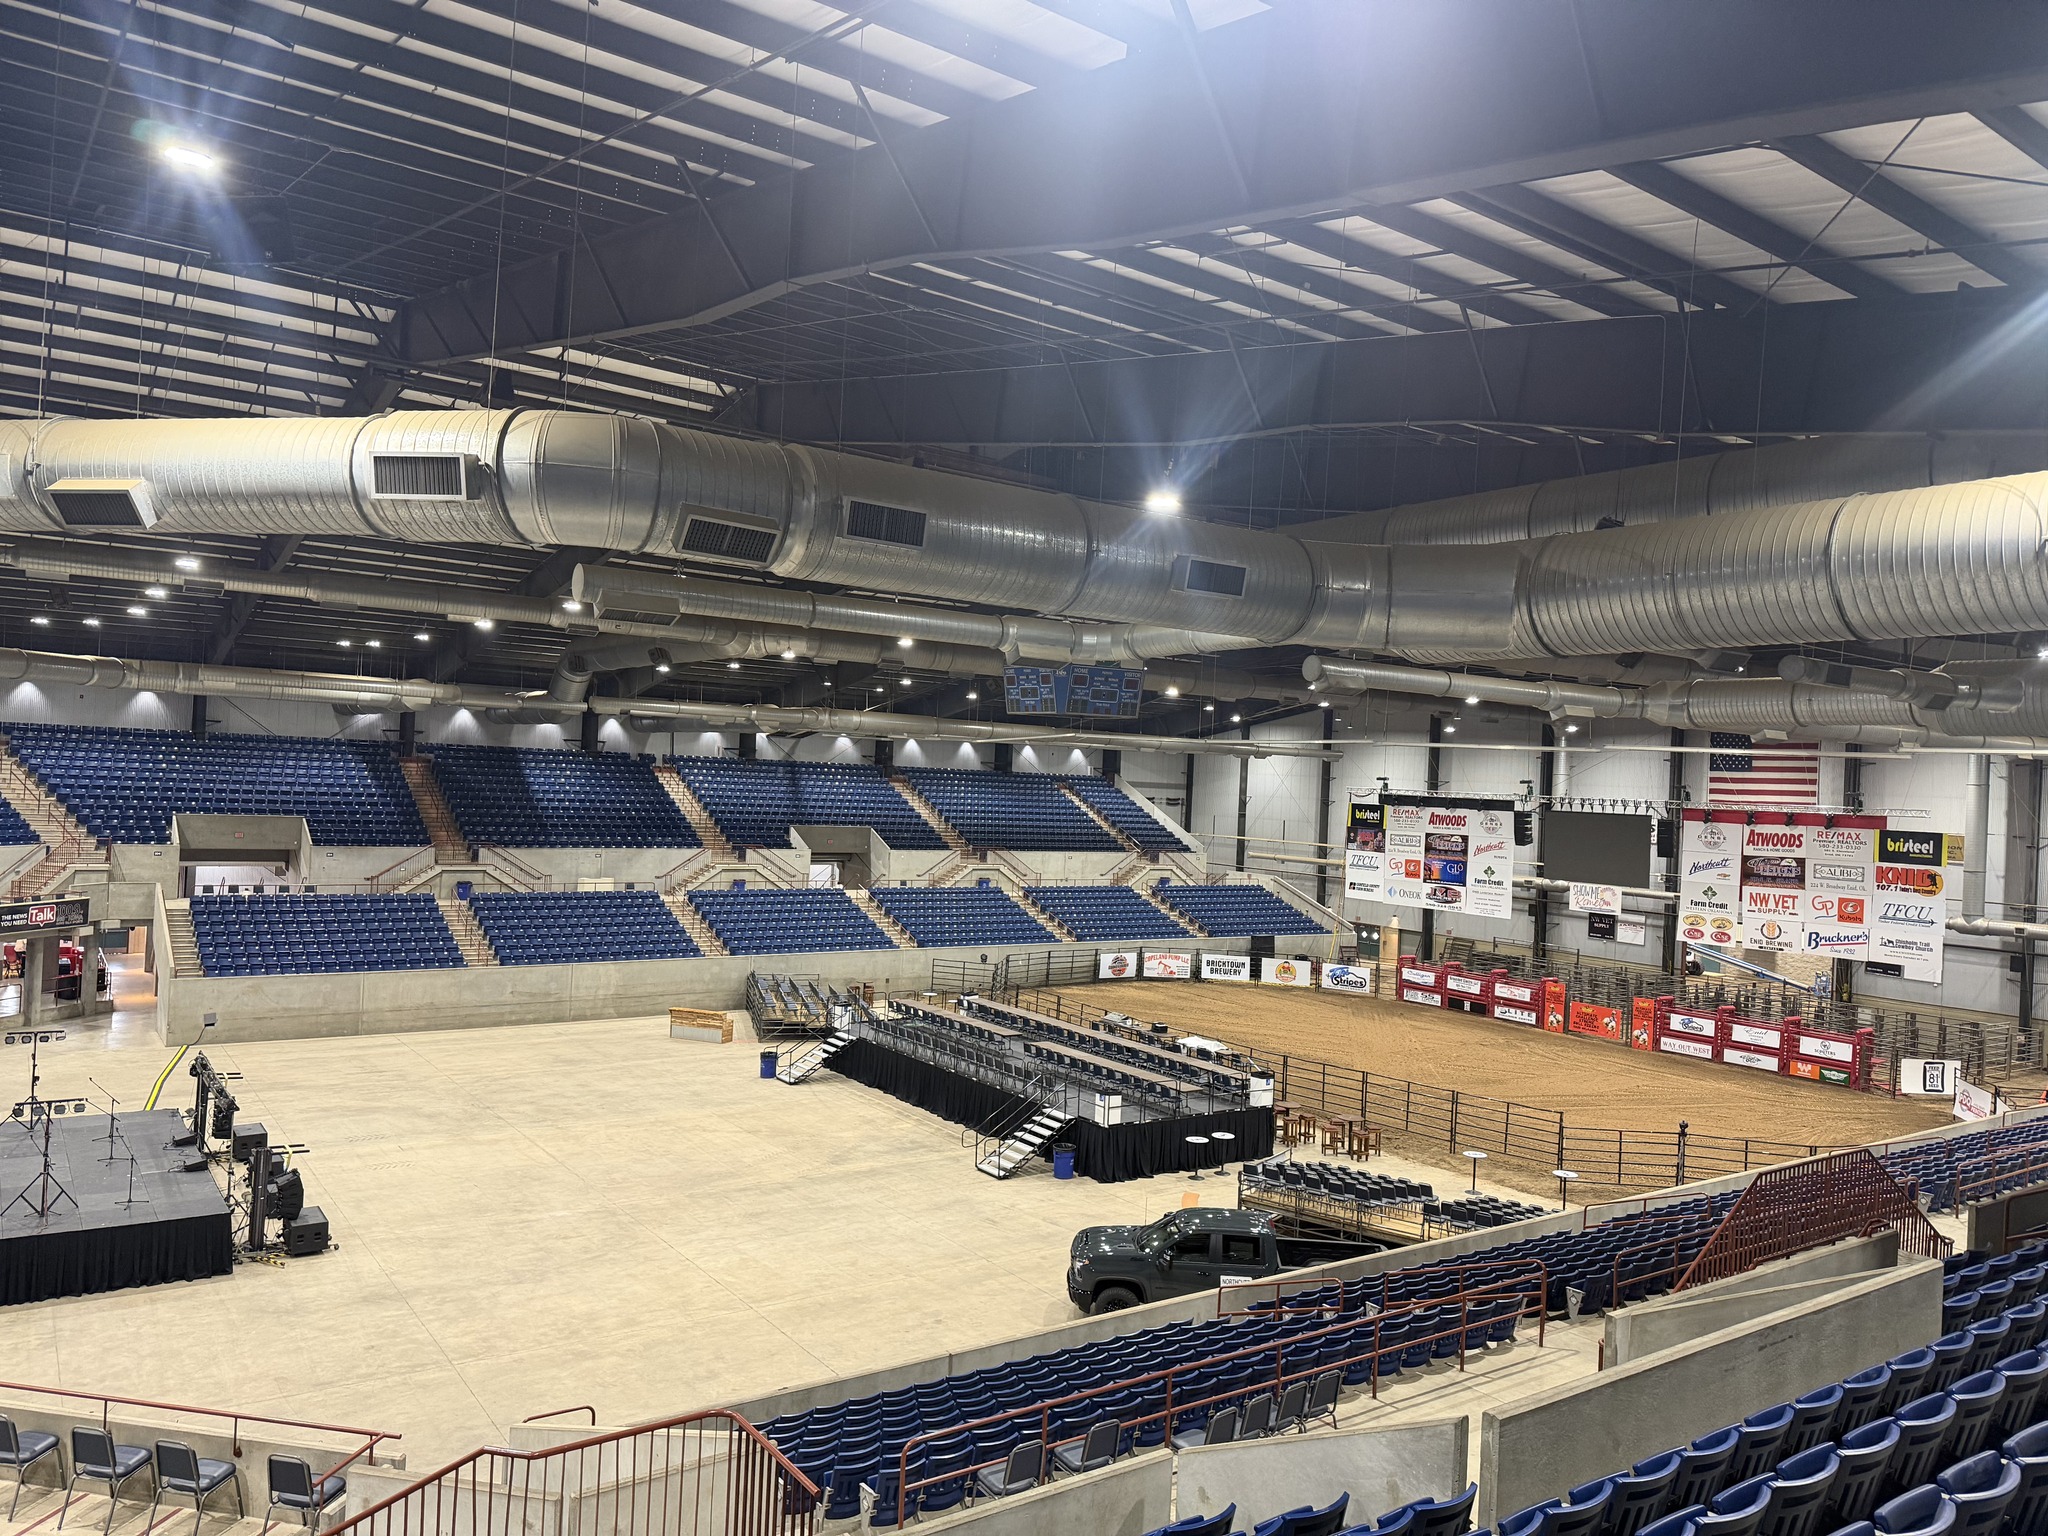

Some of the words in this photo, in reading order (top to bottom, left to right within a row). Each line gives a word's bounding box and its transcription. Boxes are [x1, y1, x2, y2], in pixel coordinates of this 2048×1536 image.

[1746, 829, 1803, 848] ATWOODS
[1817, 831, 1861, 840] RE/MAX
[1887, 837, 1933, 854] bristeel
[1826, 868, 1852, 877] ALIBI
[1749, 892, 1771, 907] NW
[1773, 894, 1798, 910] VET
[31, 908, 54, 921] Talk
[1882, 903, 1934, 920] TFCU
[1766, 940, 1792, 948] BREWING
[1808, 932, 1867, 949] Bruckner's
[1206, 960, 1246, 968] BRICKTOWN
[1210, 968, 1242, 976] BREWERY
[1334, 976, 1363, 986] Stripes
[1693, 1046, 1710, 1054] WEST
[1929, 1074, 1939, 1084] 81
